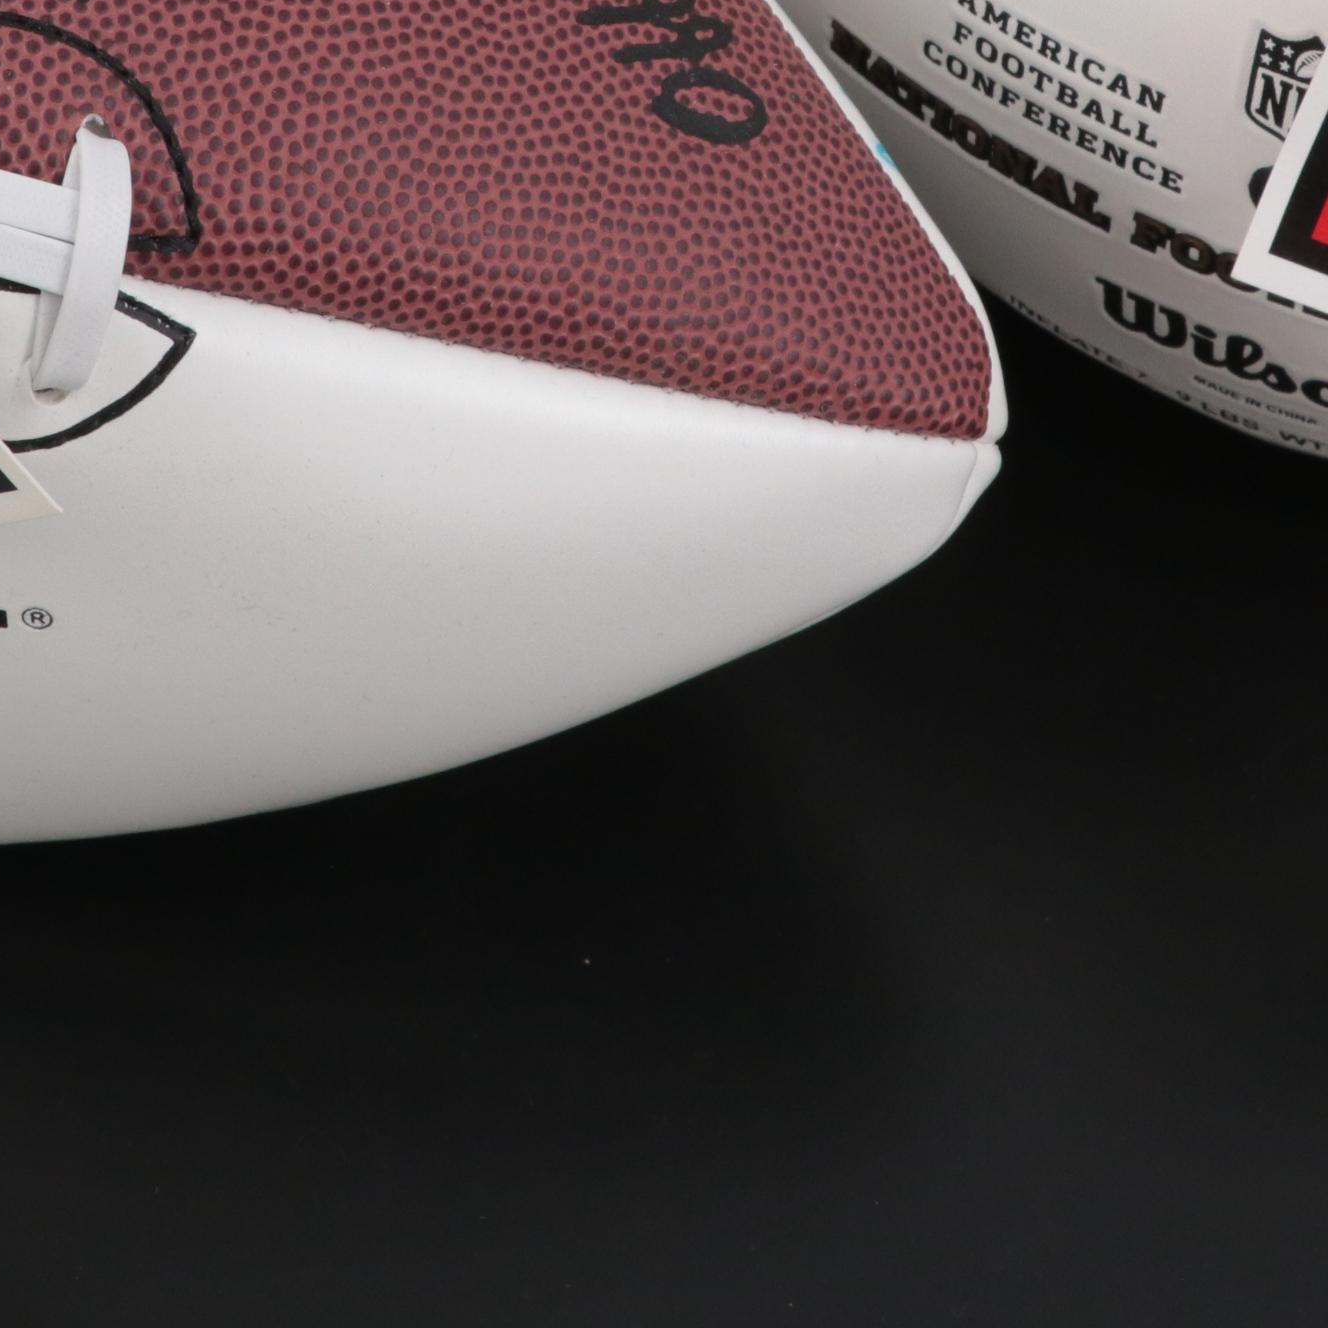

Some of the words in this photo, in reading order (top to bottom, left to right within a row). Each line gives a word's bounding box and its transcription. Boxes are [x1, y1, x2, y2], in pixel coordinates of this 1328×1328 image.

[829, 17, 1112, 232] NATIONAL
[922, 38, 1184, 195] CONFERENCE
[952, 20, 1159, 149] FOOTBALL
[1192, 374, 1240, 401] MADE
[1245, 396, 1262, 409] IN
